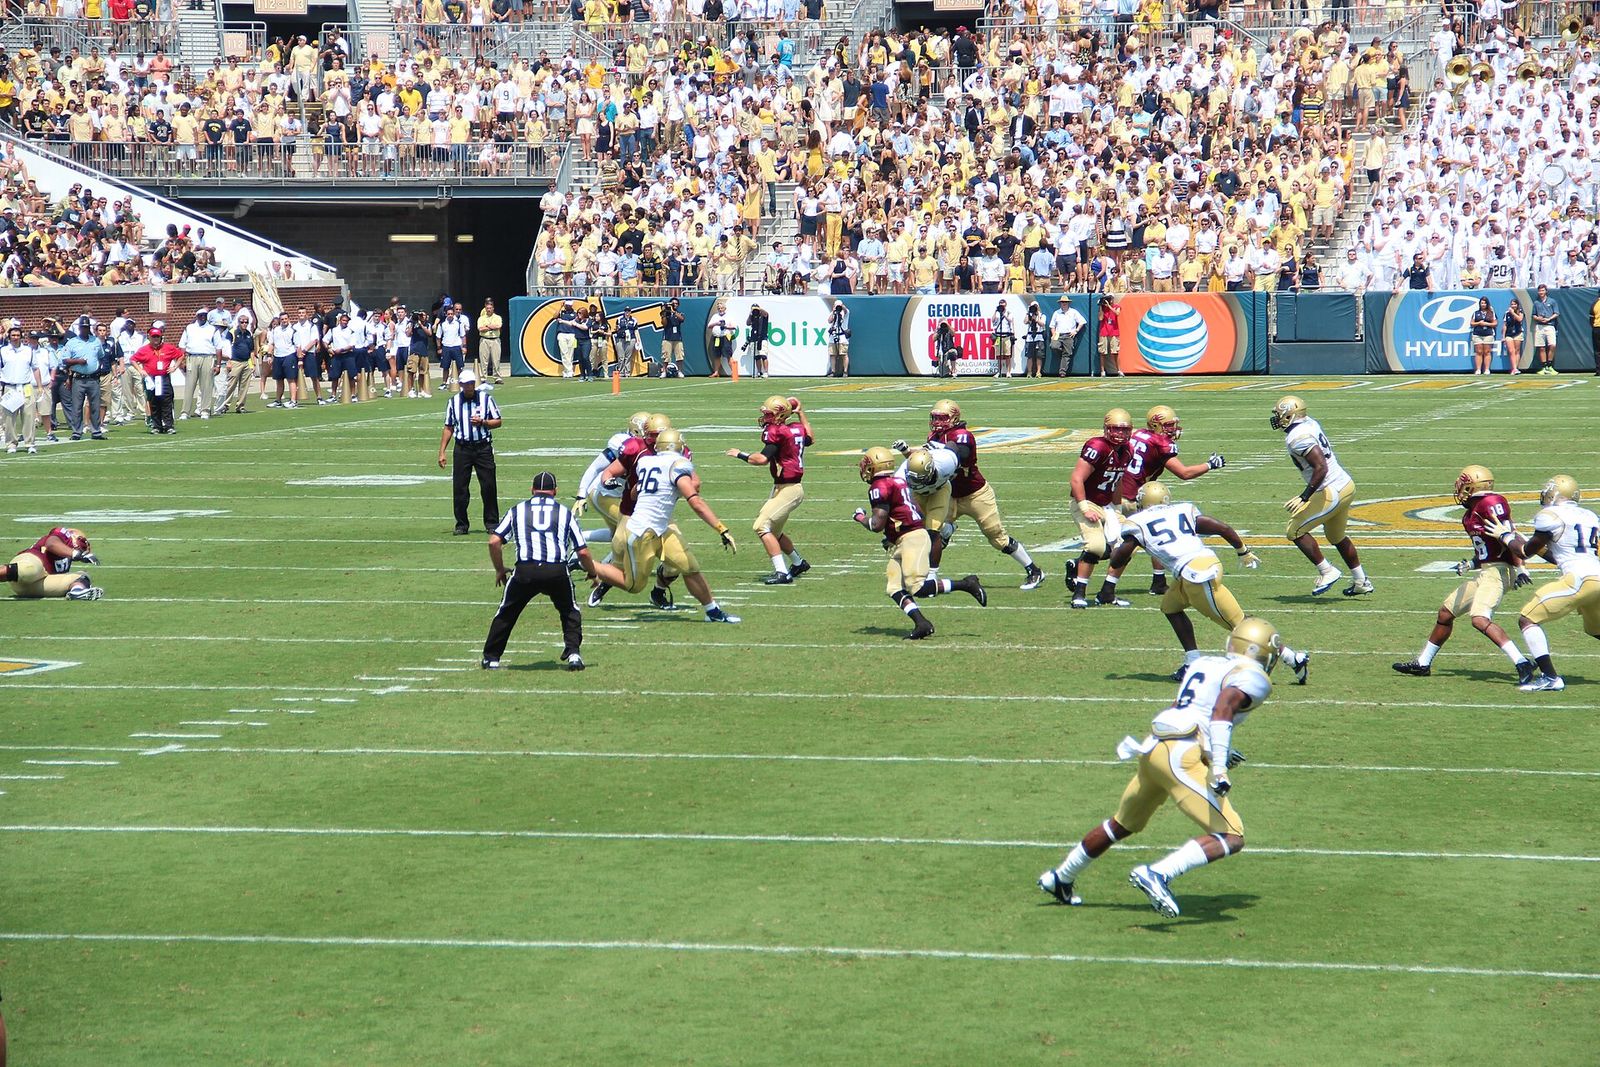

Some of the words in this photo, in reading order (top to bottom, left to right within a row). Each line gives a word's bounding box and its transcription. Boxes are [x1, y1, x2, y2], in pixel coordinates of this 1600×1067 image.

[227, 39, 243, 49] 112
[503, 90, 510, 101] 9
[1493, 264, 1507, 277] 20
[928, 303, 981, 317] GEORGIA
[928, 318, 994, 332] NTIONAL
[956, 434, 968, 444] 71
[1084, 447, 1098, 460] 70
[869, 488, 880, 500] 10
[1488, 503, 1505, 517] 18
[530, 505, 554, 531] U
[1146, 513, 1197, 546] 54
[1176, 671, 1206, 710] 6
